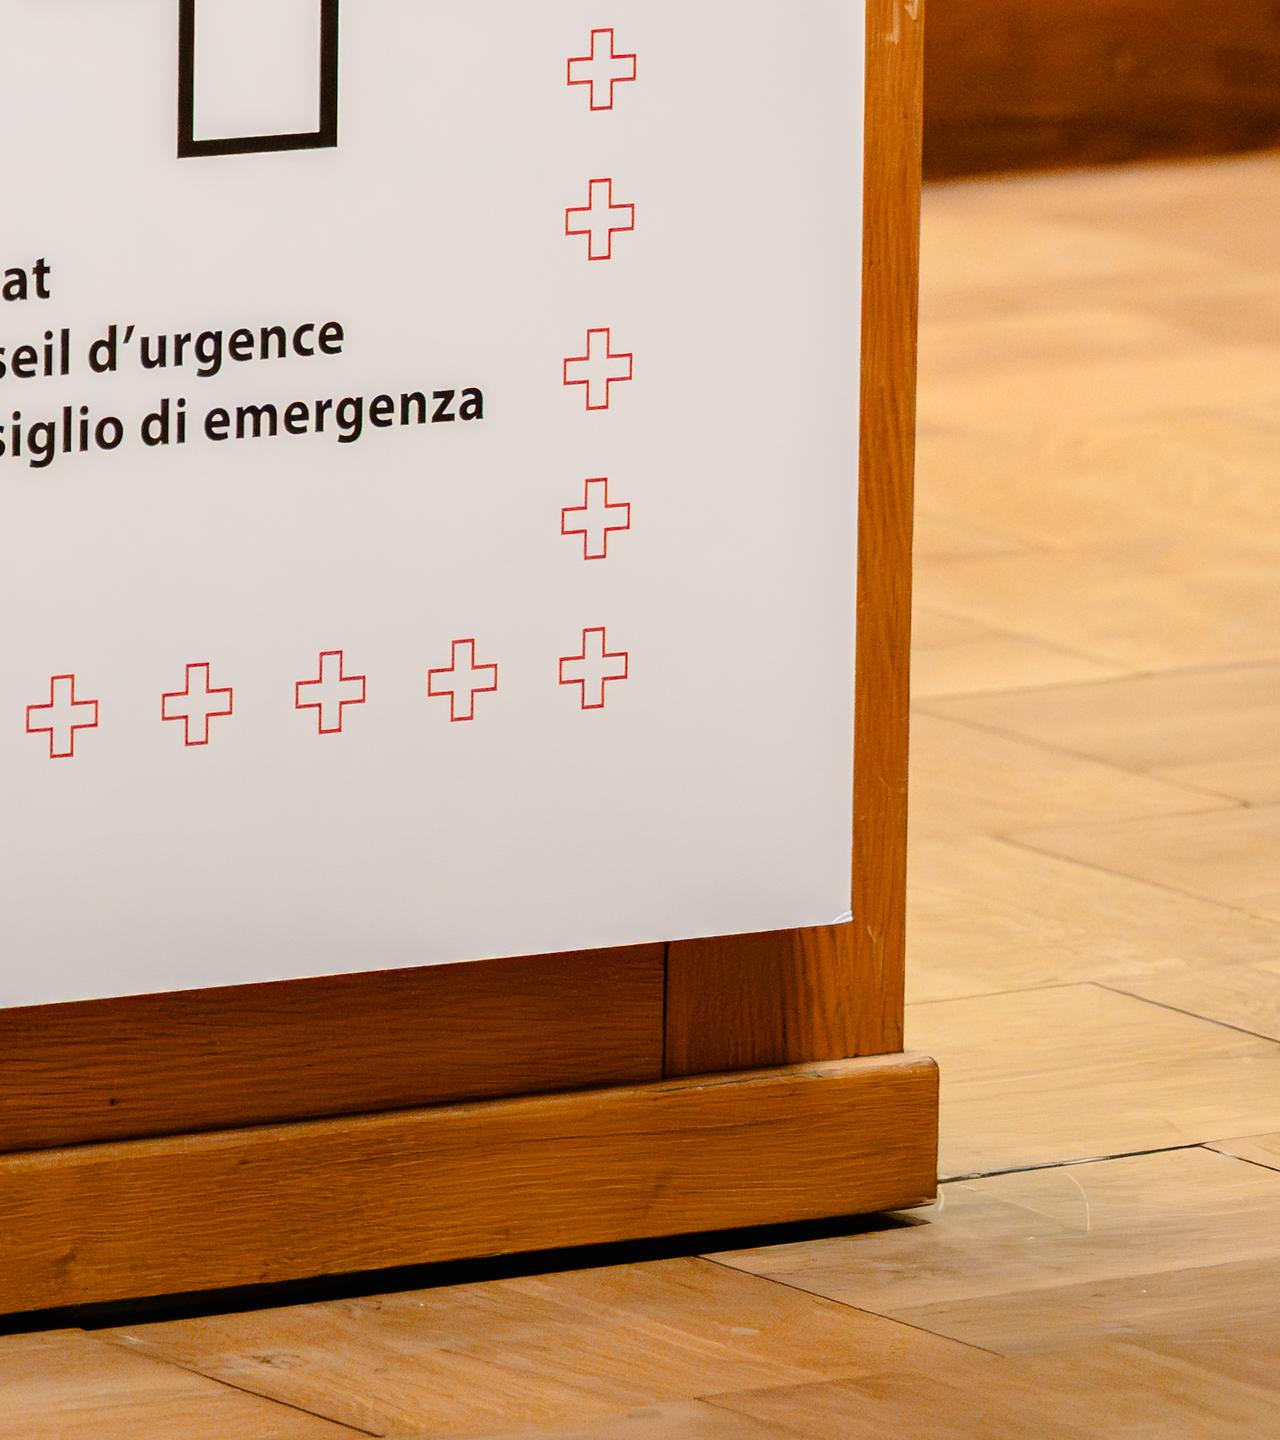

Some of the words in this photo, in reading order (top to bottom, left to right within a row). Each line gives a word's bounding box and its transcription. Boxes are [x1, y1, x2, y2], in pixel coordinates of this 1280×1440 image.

[87, 320, 345, 378] d’urgence
[139, 397, 187, 447] di
[203, 386, 485, 444] emergenza
